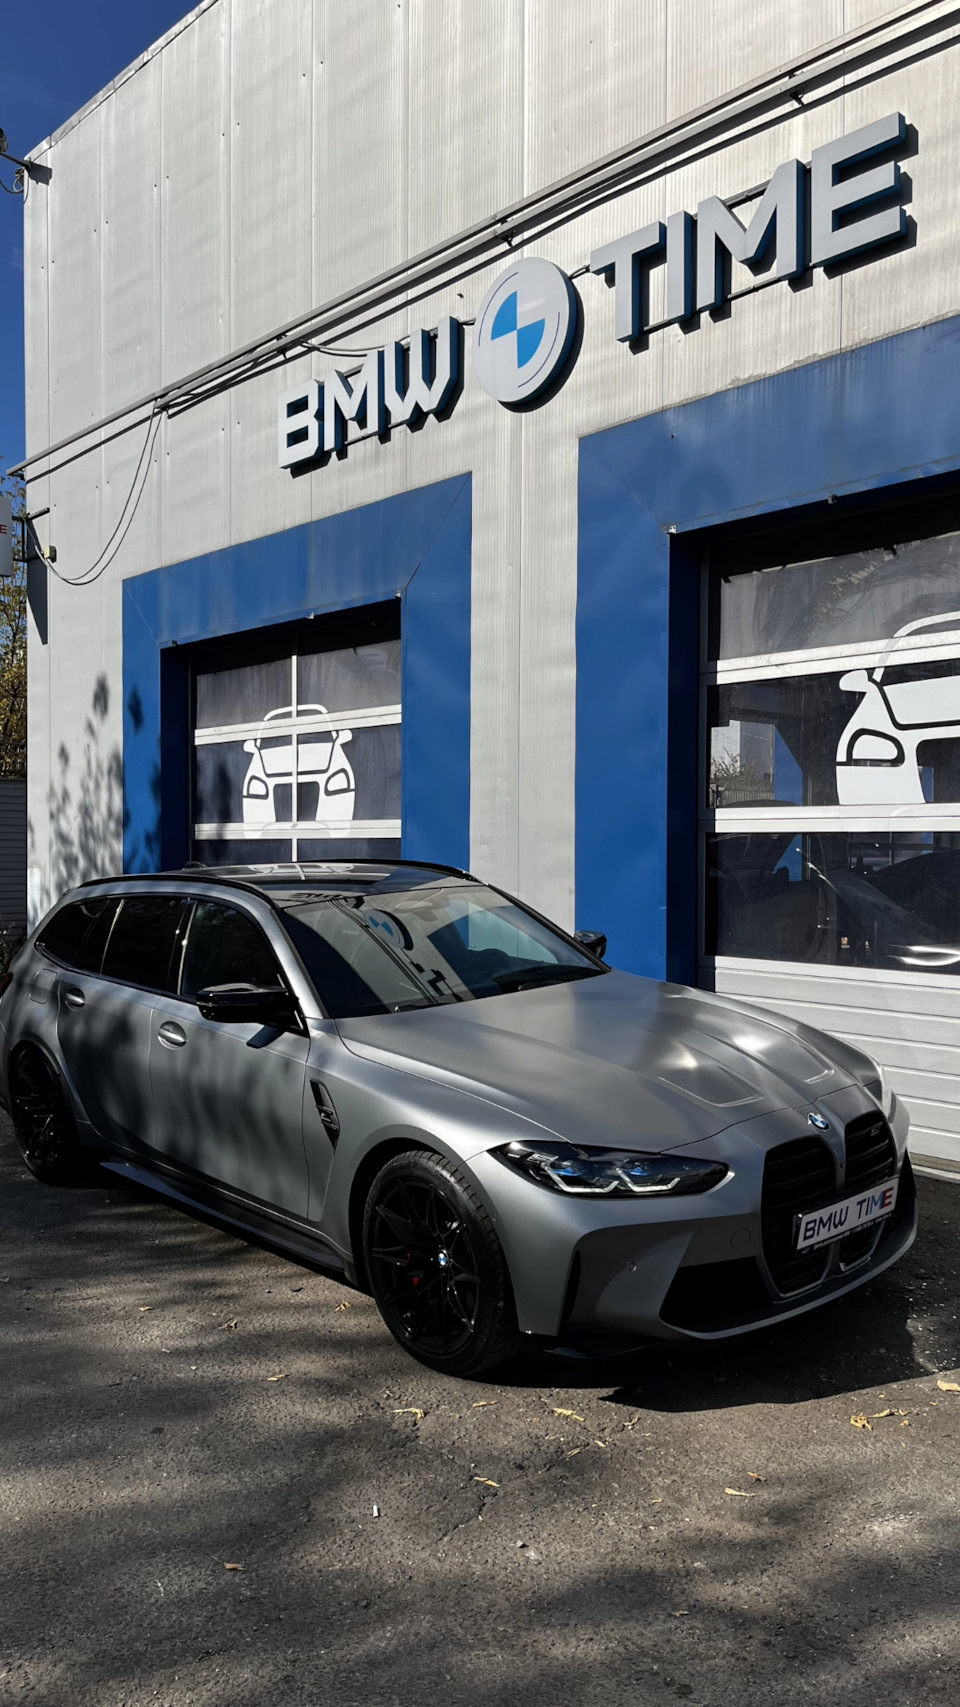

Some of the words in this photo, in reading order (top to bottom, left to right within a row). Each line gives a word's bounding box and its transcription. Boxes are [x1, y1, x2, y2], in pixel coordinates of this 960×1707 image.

[278, 316, 459, 469] BMW
[590, 111, 906, 343] TIME
[803, 1206, 849, 1241] BMW
[857, 1186, 894, 1219] TIME
